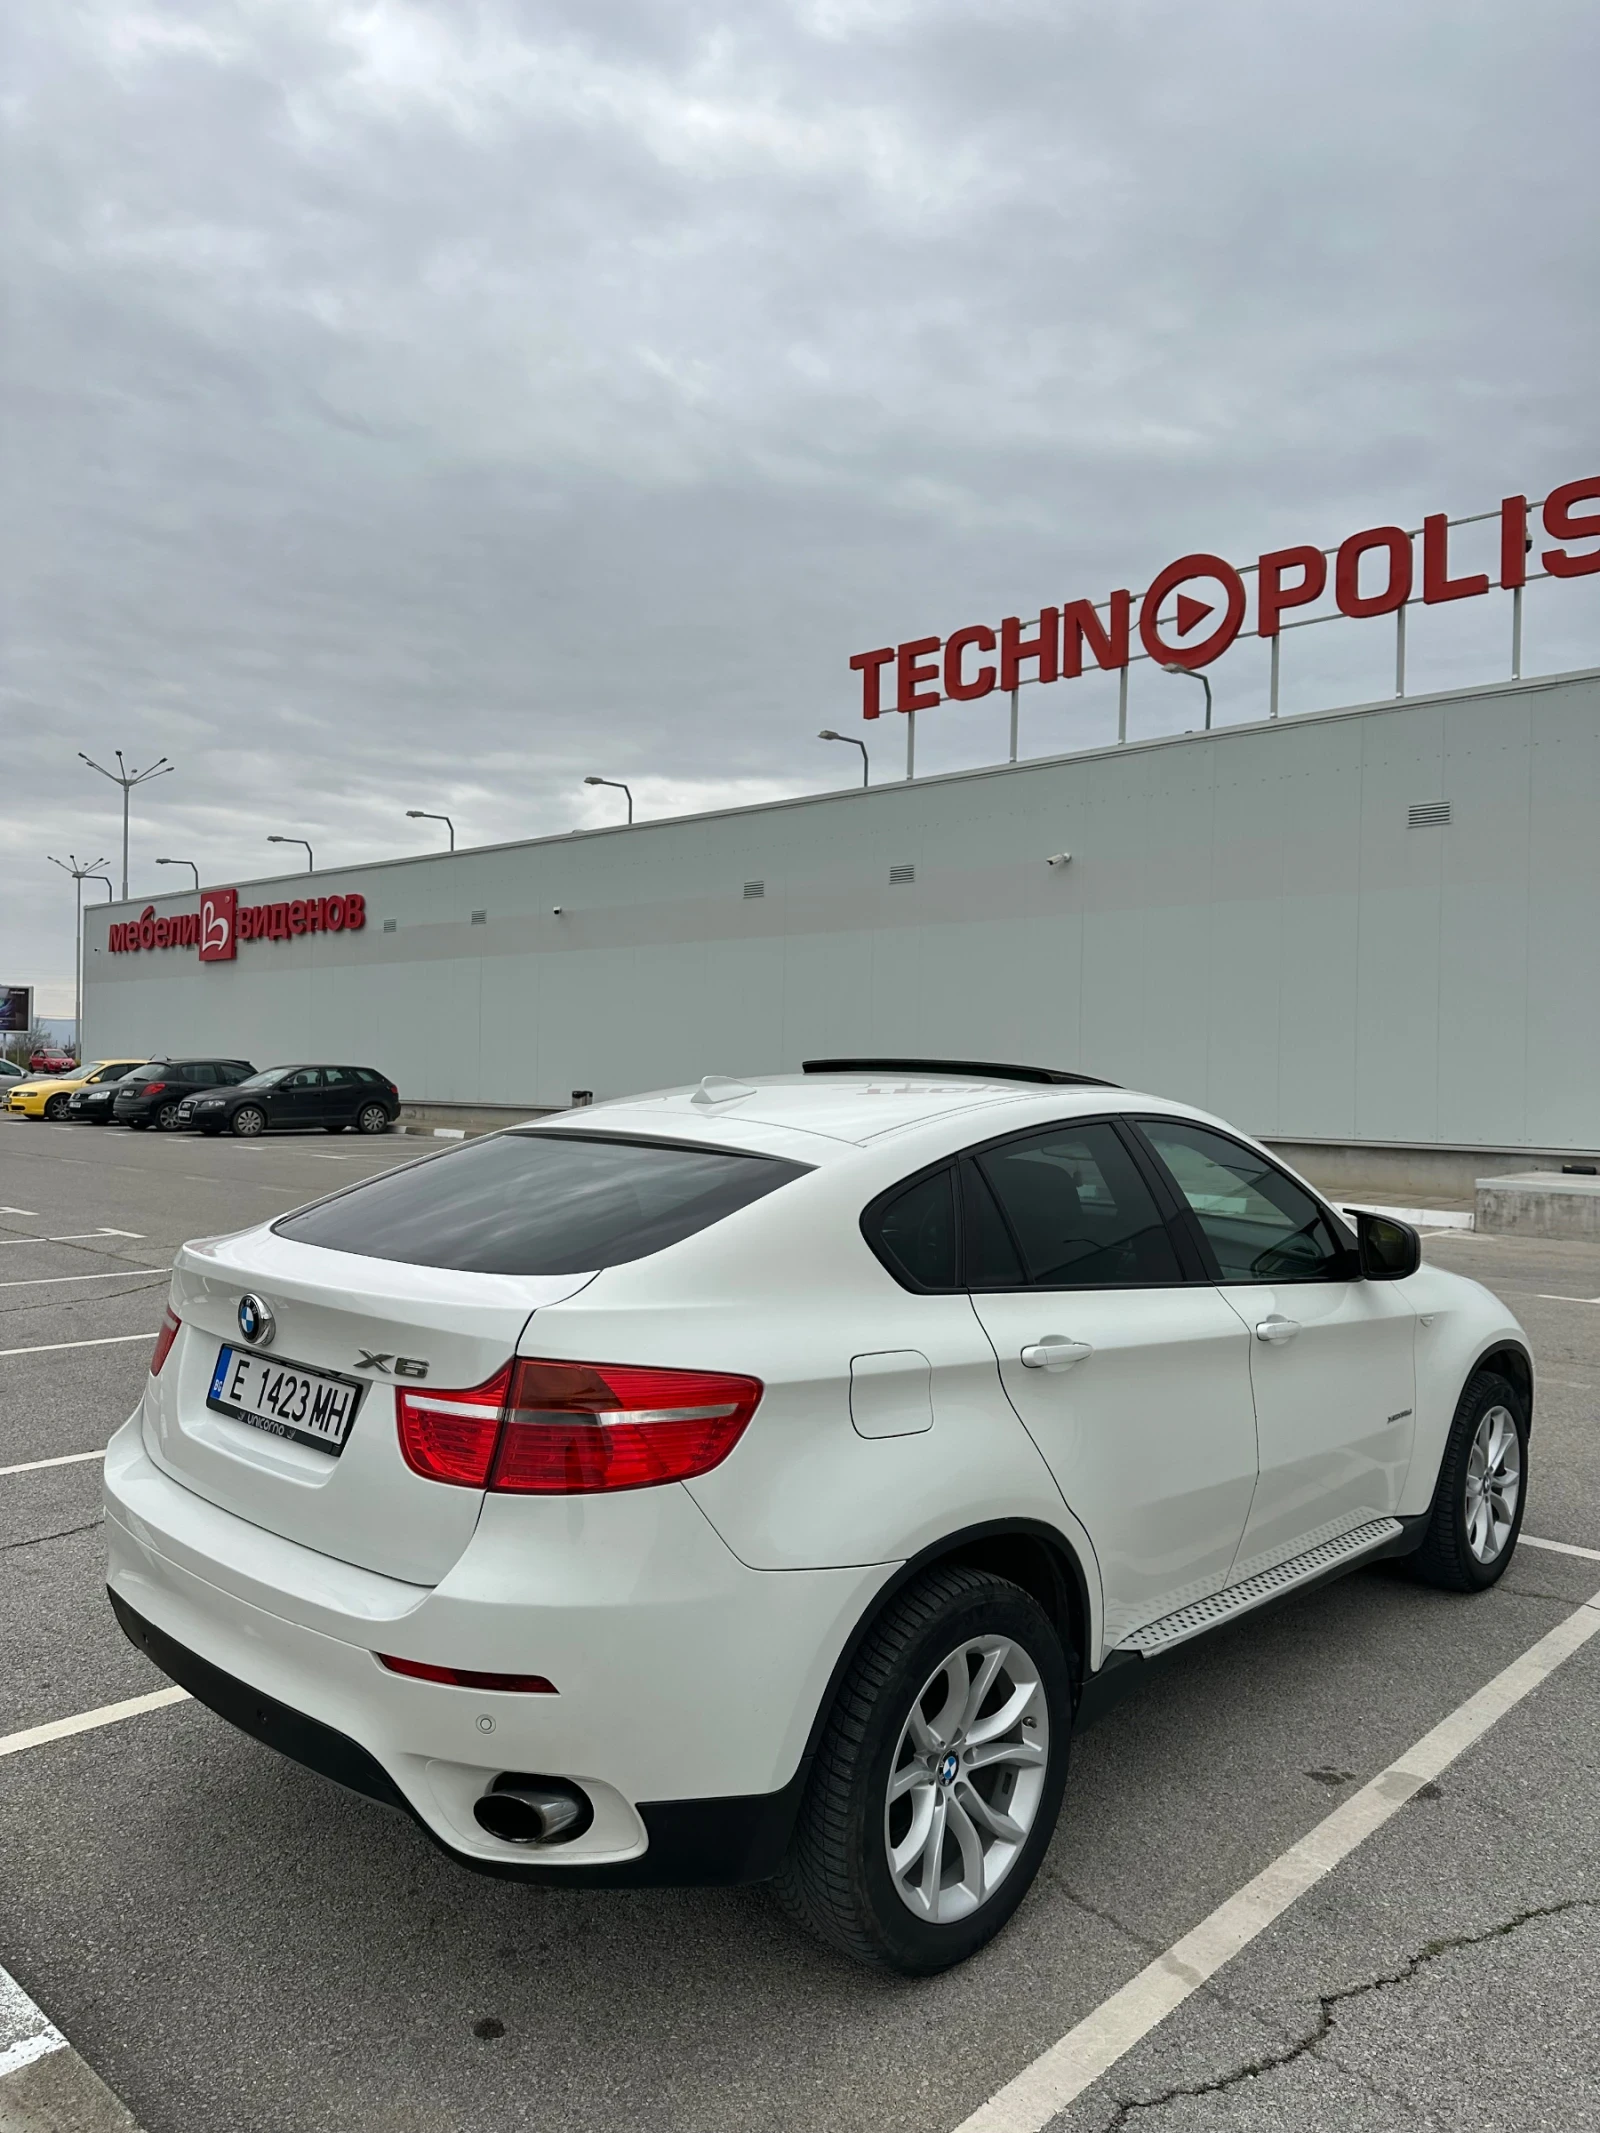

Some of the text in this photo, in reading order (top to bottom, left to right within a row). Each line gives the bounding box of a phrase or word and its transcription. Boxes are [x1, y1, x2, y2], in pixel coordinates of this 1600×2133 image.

[850, 475, 1600, 720] TECHNOPOLIS
[109, 906, 200, 952] мебели
[237, 893, 366, 940] виденов
[353, 1348, 430, 1379] X6
[247, 1412, 285, 1436] unicorno
